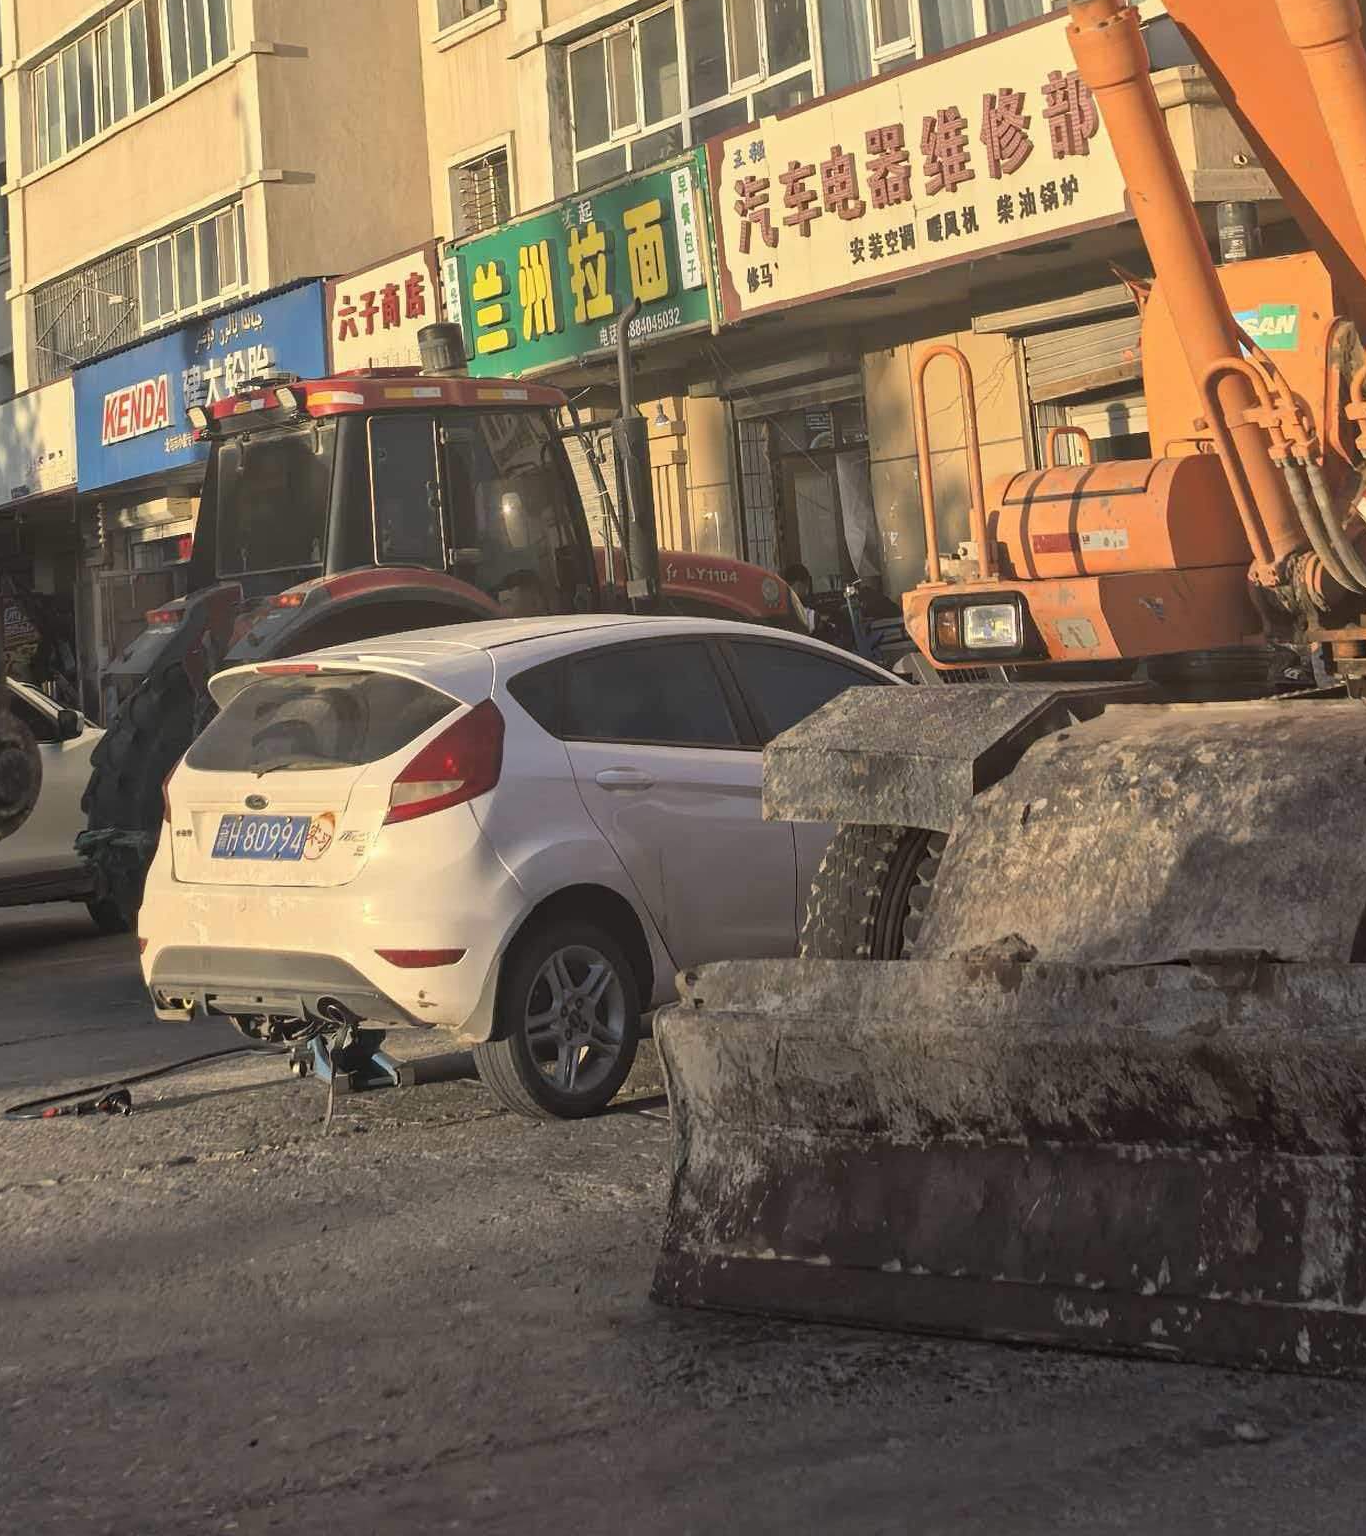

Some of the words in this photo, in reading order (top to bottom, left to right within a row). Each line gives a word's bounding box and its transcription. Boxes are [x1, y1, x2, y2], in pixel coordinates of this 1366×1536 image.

[733, 69, 1101, 255] 汽车电器维修部
[849, 222, 916, 265] 安装空调
[926, 205, 980, 243] 暖风机
[996, 173, 1080, 224] 柴油锅炉
[337, 271, 426, 342] 六子商店
[472, 198, 669, 354] 兰州拉面
[746, 262, 779, 293] 修马
[102, 376, 171, 442] KENDA
[182, 343, 277, 408] 建大轮胎
